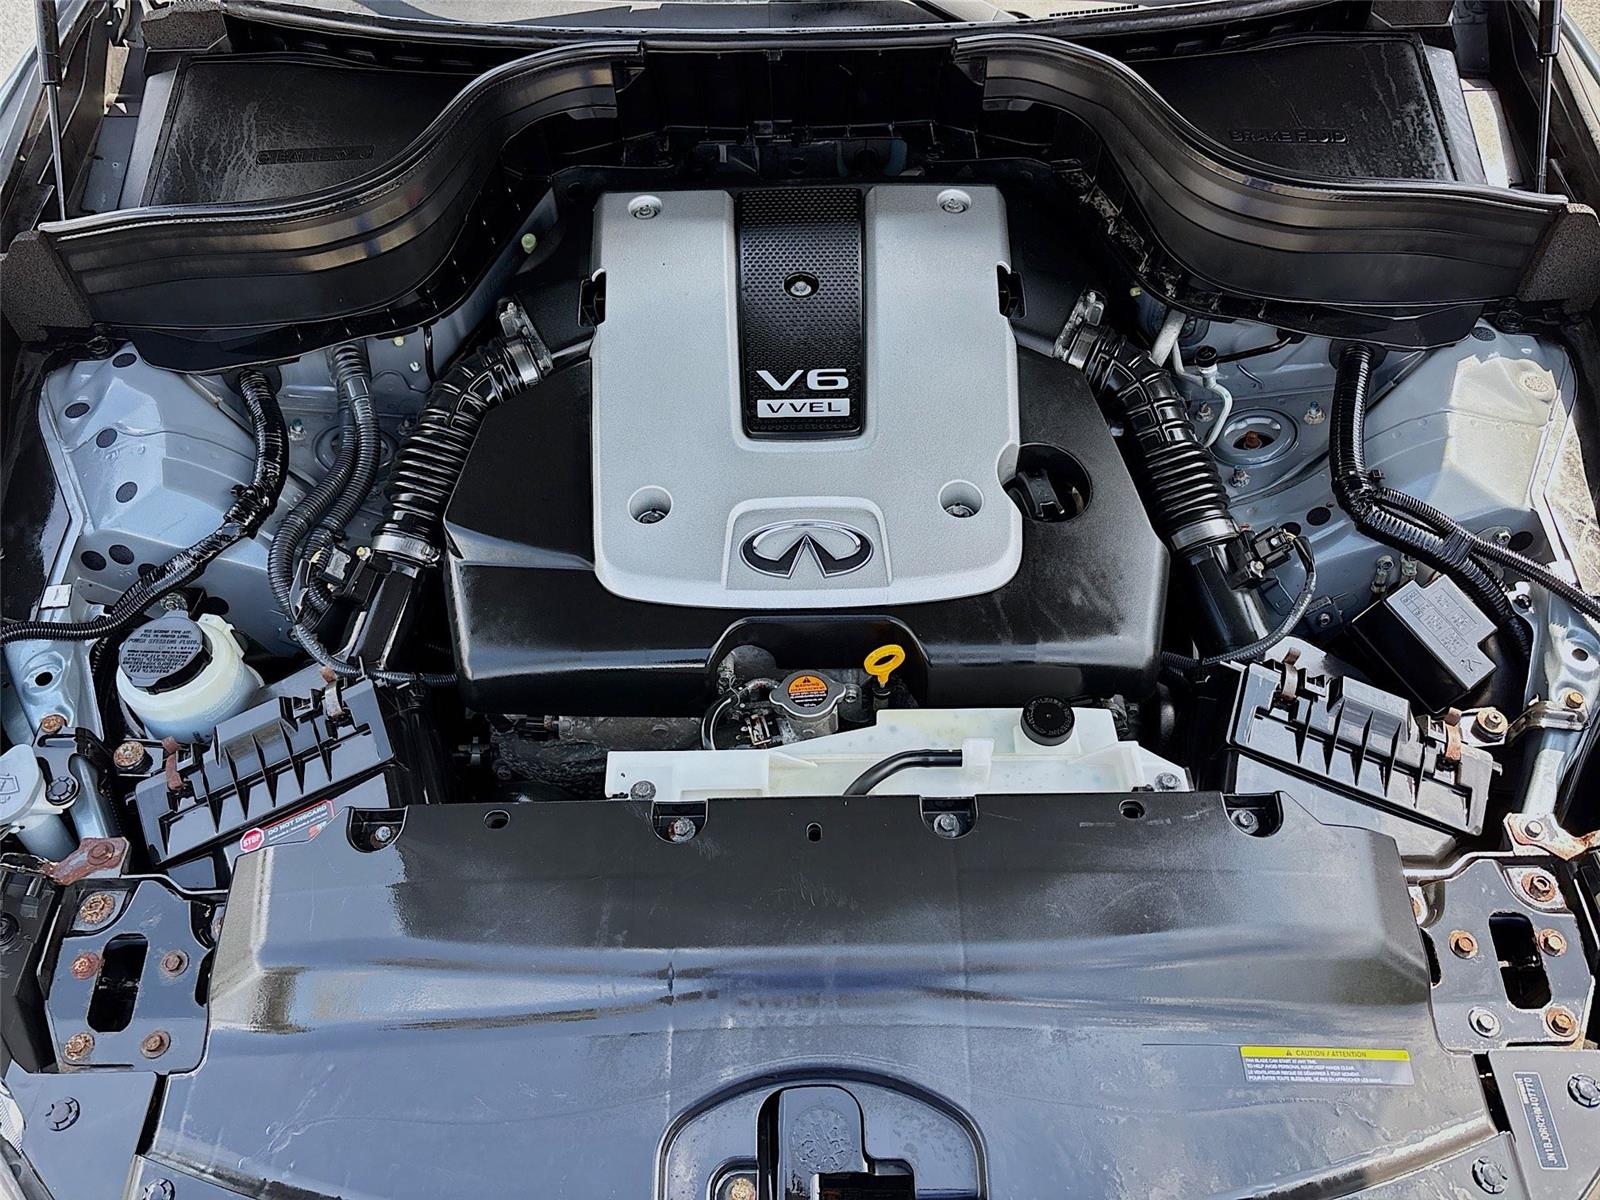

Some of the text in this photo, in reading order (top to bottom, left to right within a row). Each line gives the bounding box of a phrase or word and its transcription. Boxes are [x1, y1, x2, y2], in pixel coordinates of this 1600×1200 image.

[1297, 130, 1346, 142] FLUID
[756, 368, 849, 391] V6
[767, 402, 842, 414] VVEL
[268, 805, 327, 836] DO NOT DISCARD
[243, 834, 261, 848] STOP
[1332, 1050, 1367, 1058] ATTENTION
